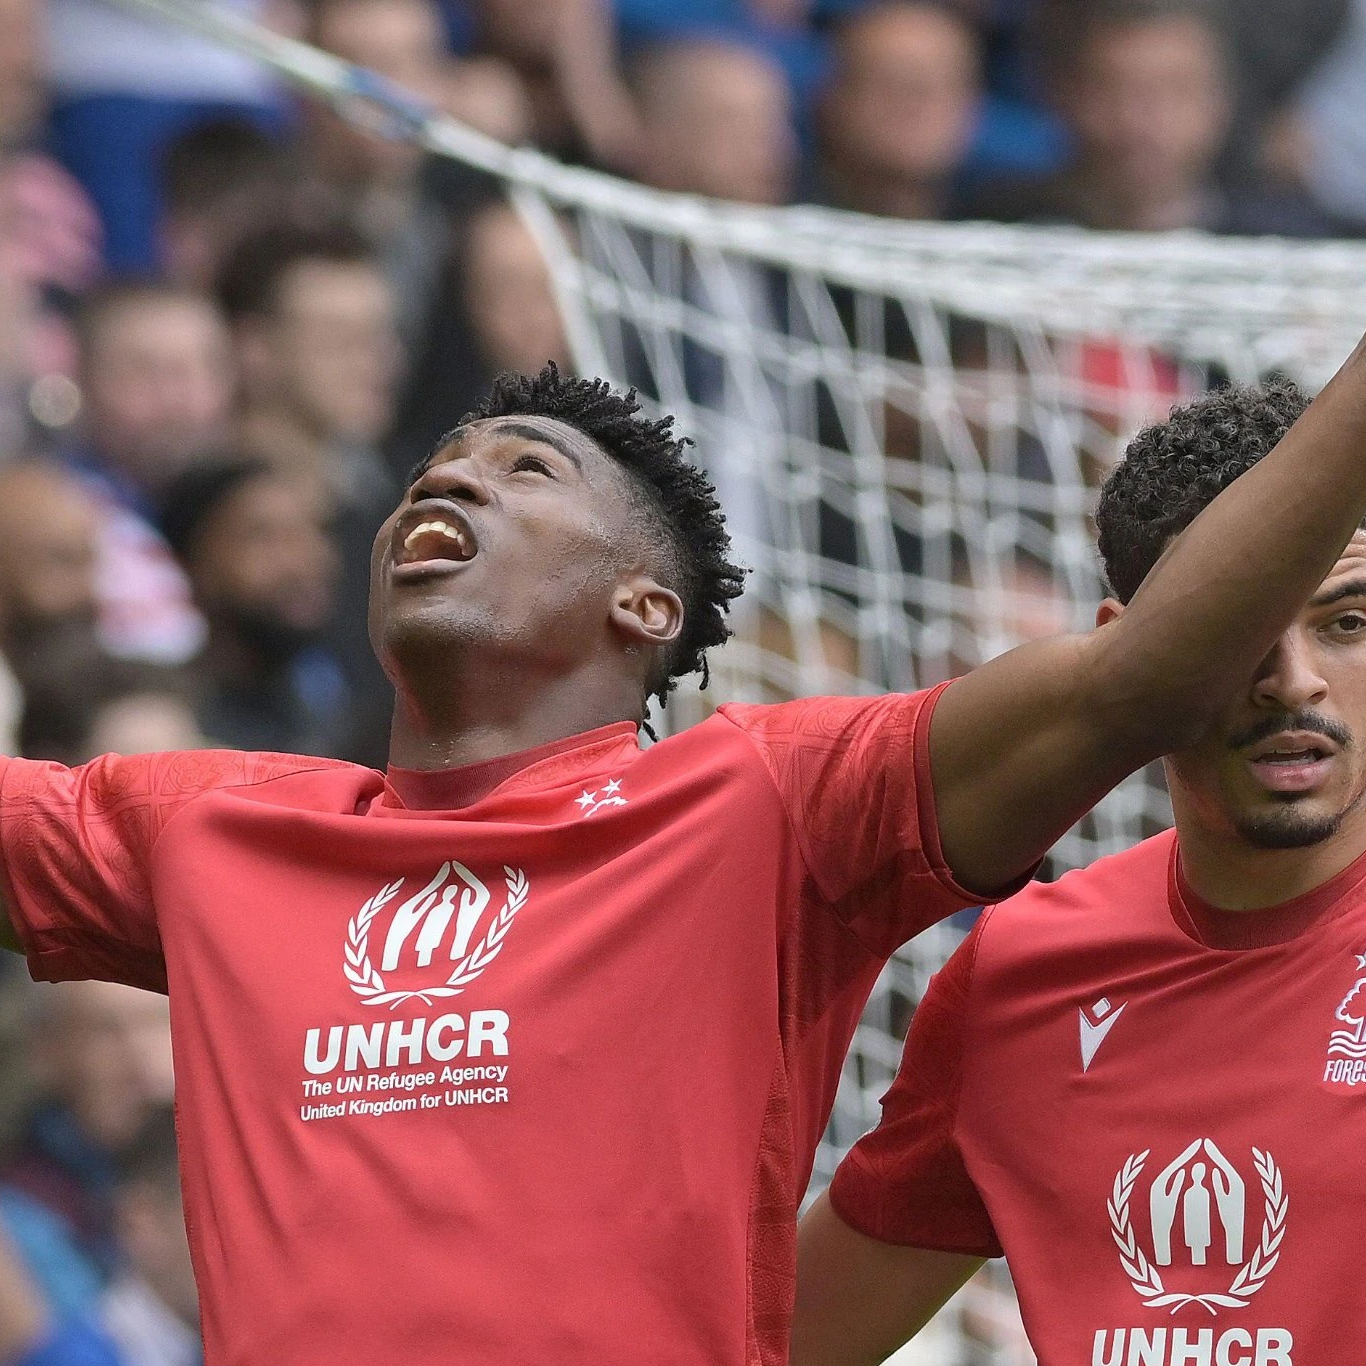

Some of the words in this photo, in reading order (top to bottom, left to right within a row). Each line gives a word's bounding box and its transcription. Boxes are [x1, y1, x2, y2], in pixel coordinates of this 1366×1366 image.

[302, 1009, 510, 1074] UNHCR
[302, 1079, 332, 1098] The
[336, 1075, 364, 1094] UN
[366, 1069, 436, 1093] Refugee
[439, 1065, 508, 1085] Agency
[300, 1101, 346, 1121] United
[348, 1096, 417, 1117] Kingdom
[420, 1093, 442, 1110] for
[444, 1087, 509, 1107] UNHCR
